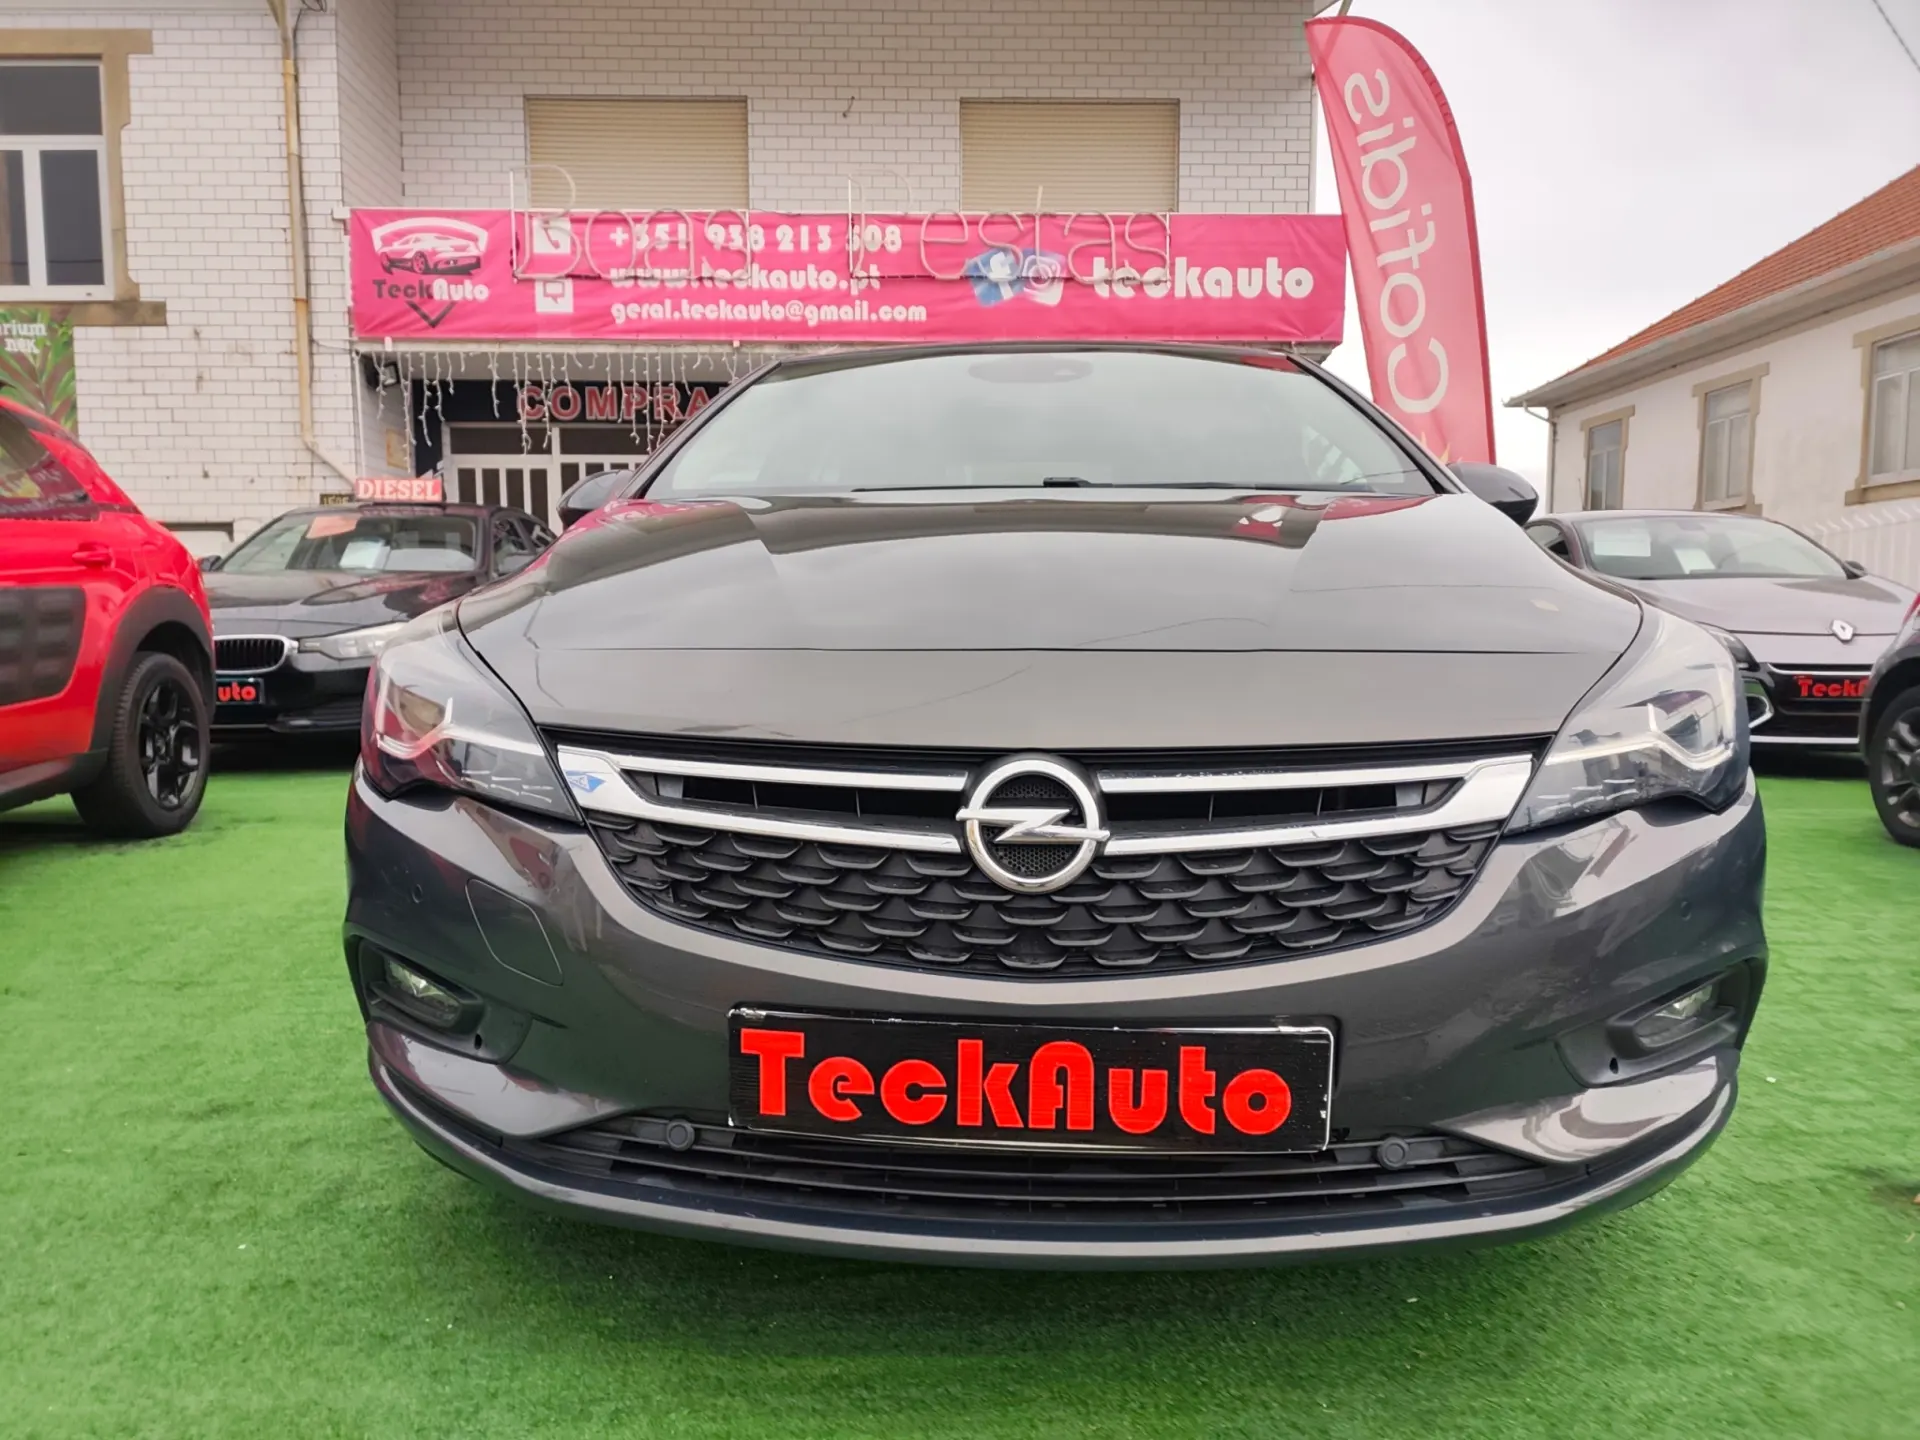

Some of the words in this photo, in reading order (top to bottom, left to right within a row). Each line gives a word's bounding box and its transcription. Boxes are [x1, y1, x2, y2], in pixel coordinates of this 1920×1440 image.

[708, 223, 765, 252] 938
[775, 224, 832, 253] 213
[371, 278, 490, 303] TeckAuto
[1093, 256, 1314, 299] teckauto
[611, 299, 927, 327] geral.teckauto@gmail.com
[516, 386, 728, 421] COMPRA
[357, 479, 441, 500] DIESEL
[740, 1027, 1293, 1136] TeckAuto
